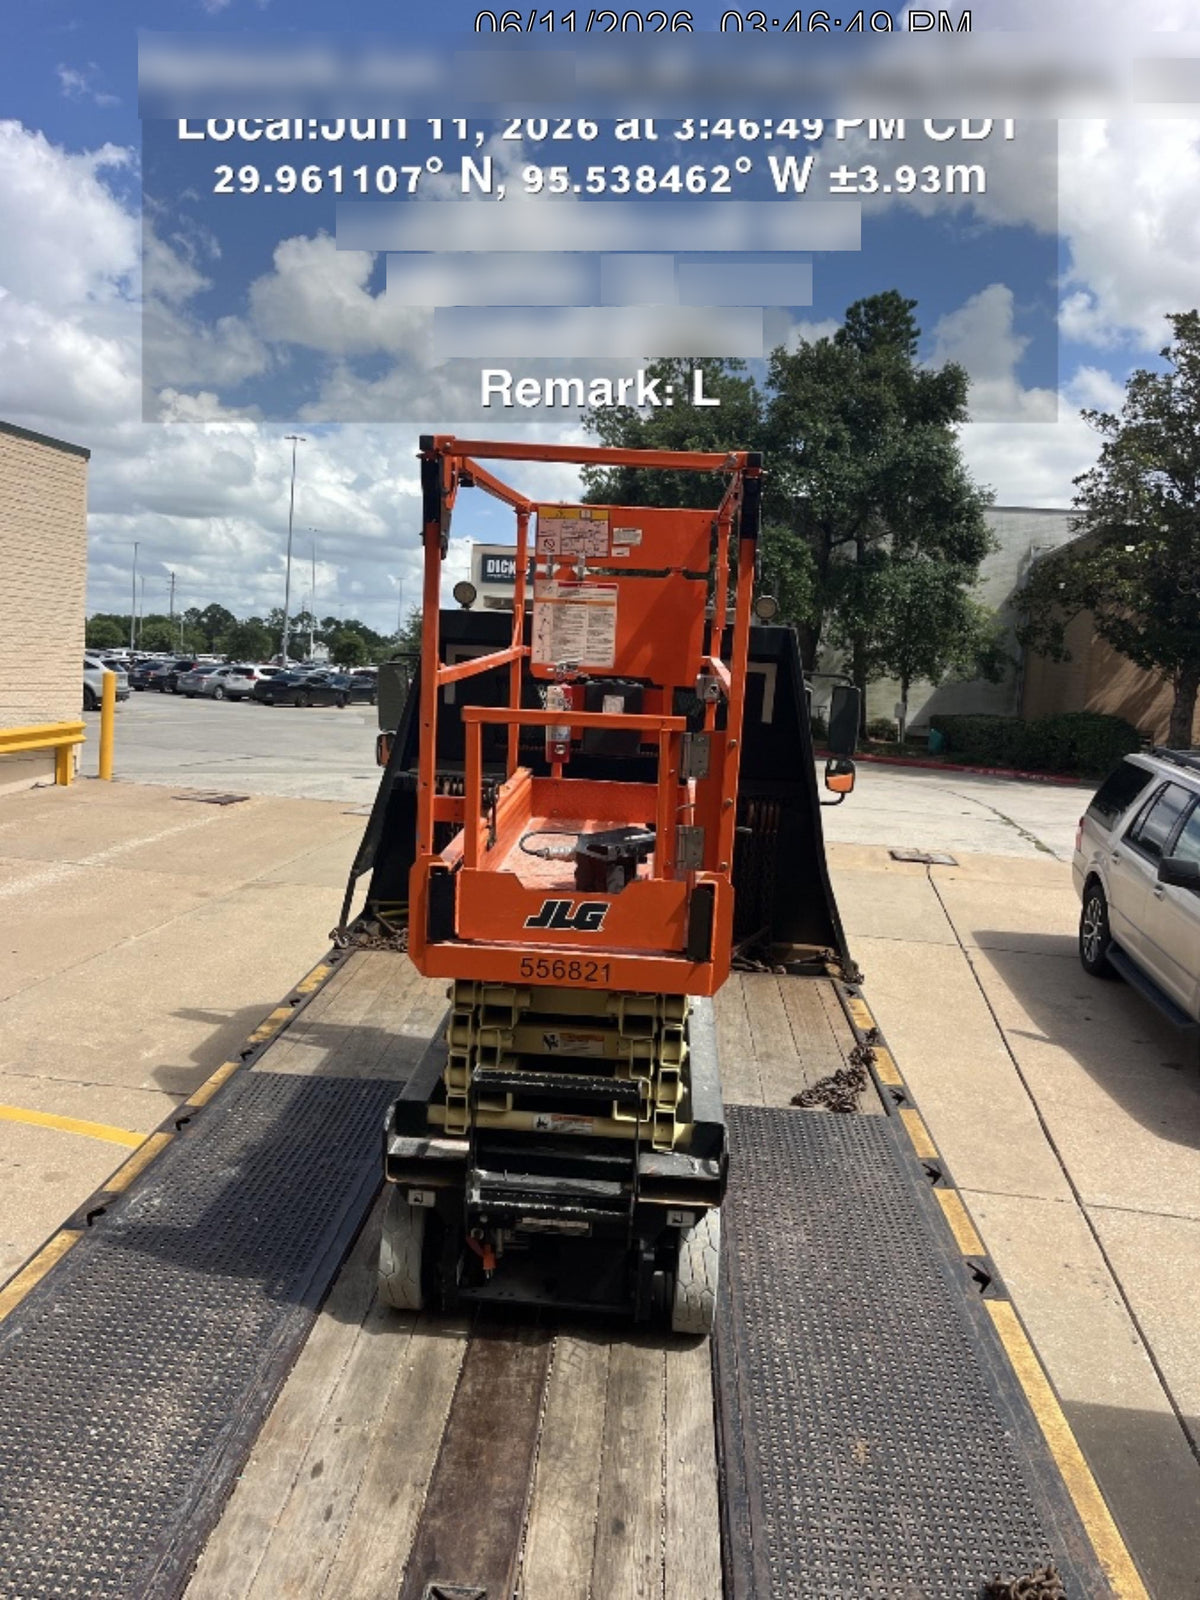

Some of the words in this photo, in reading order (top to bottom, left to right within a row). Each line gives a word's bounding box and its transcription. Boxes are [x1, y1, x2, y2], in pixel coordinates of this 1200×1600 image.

[486, 559, 530, 575] DICK
[522, 898, 612, 932] JLG
[520, 957, 611, 982] 556821
